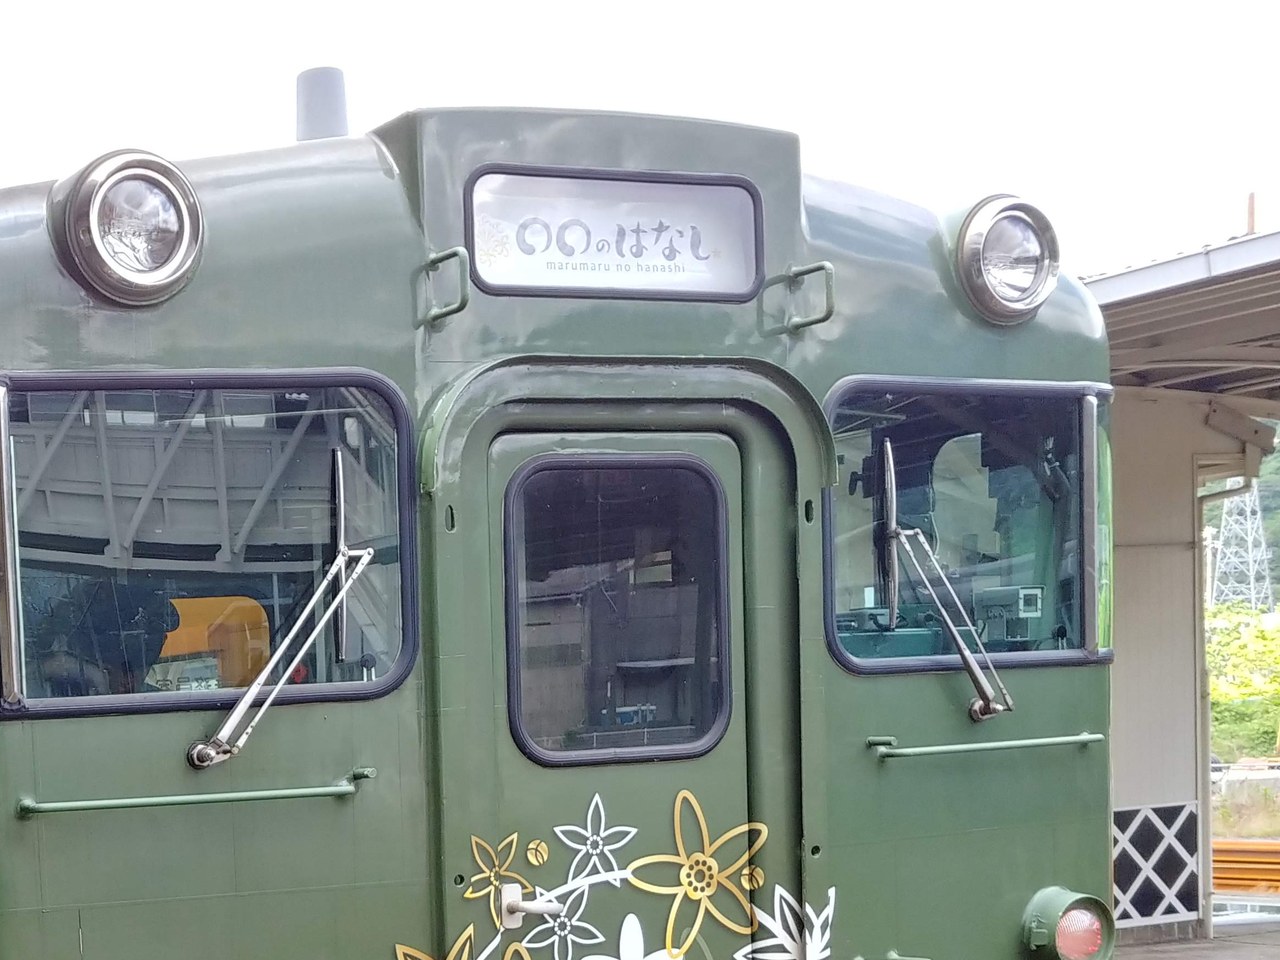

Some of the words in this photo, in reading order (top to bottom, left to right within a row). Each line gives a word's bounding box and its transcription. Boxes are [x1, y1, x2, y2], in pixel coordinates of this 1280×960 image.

[546, 260, 610, 272] marumaru
[616, 262, 631, 272] no
[636, 262, 685, 273] hanashi
